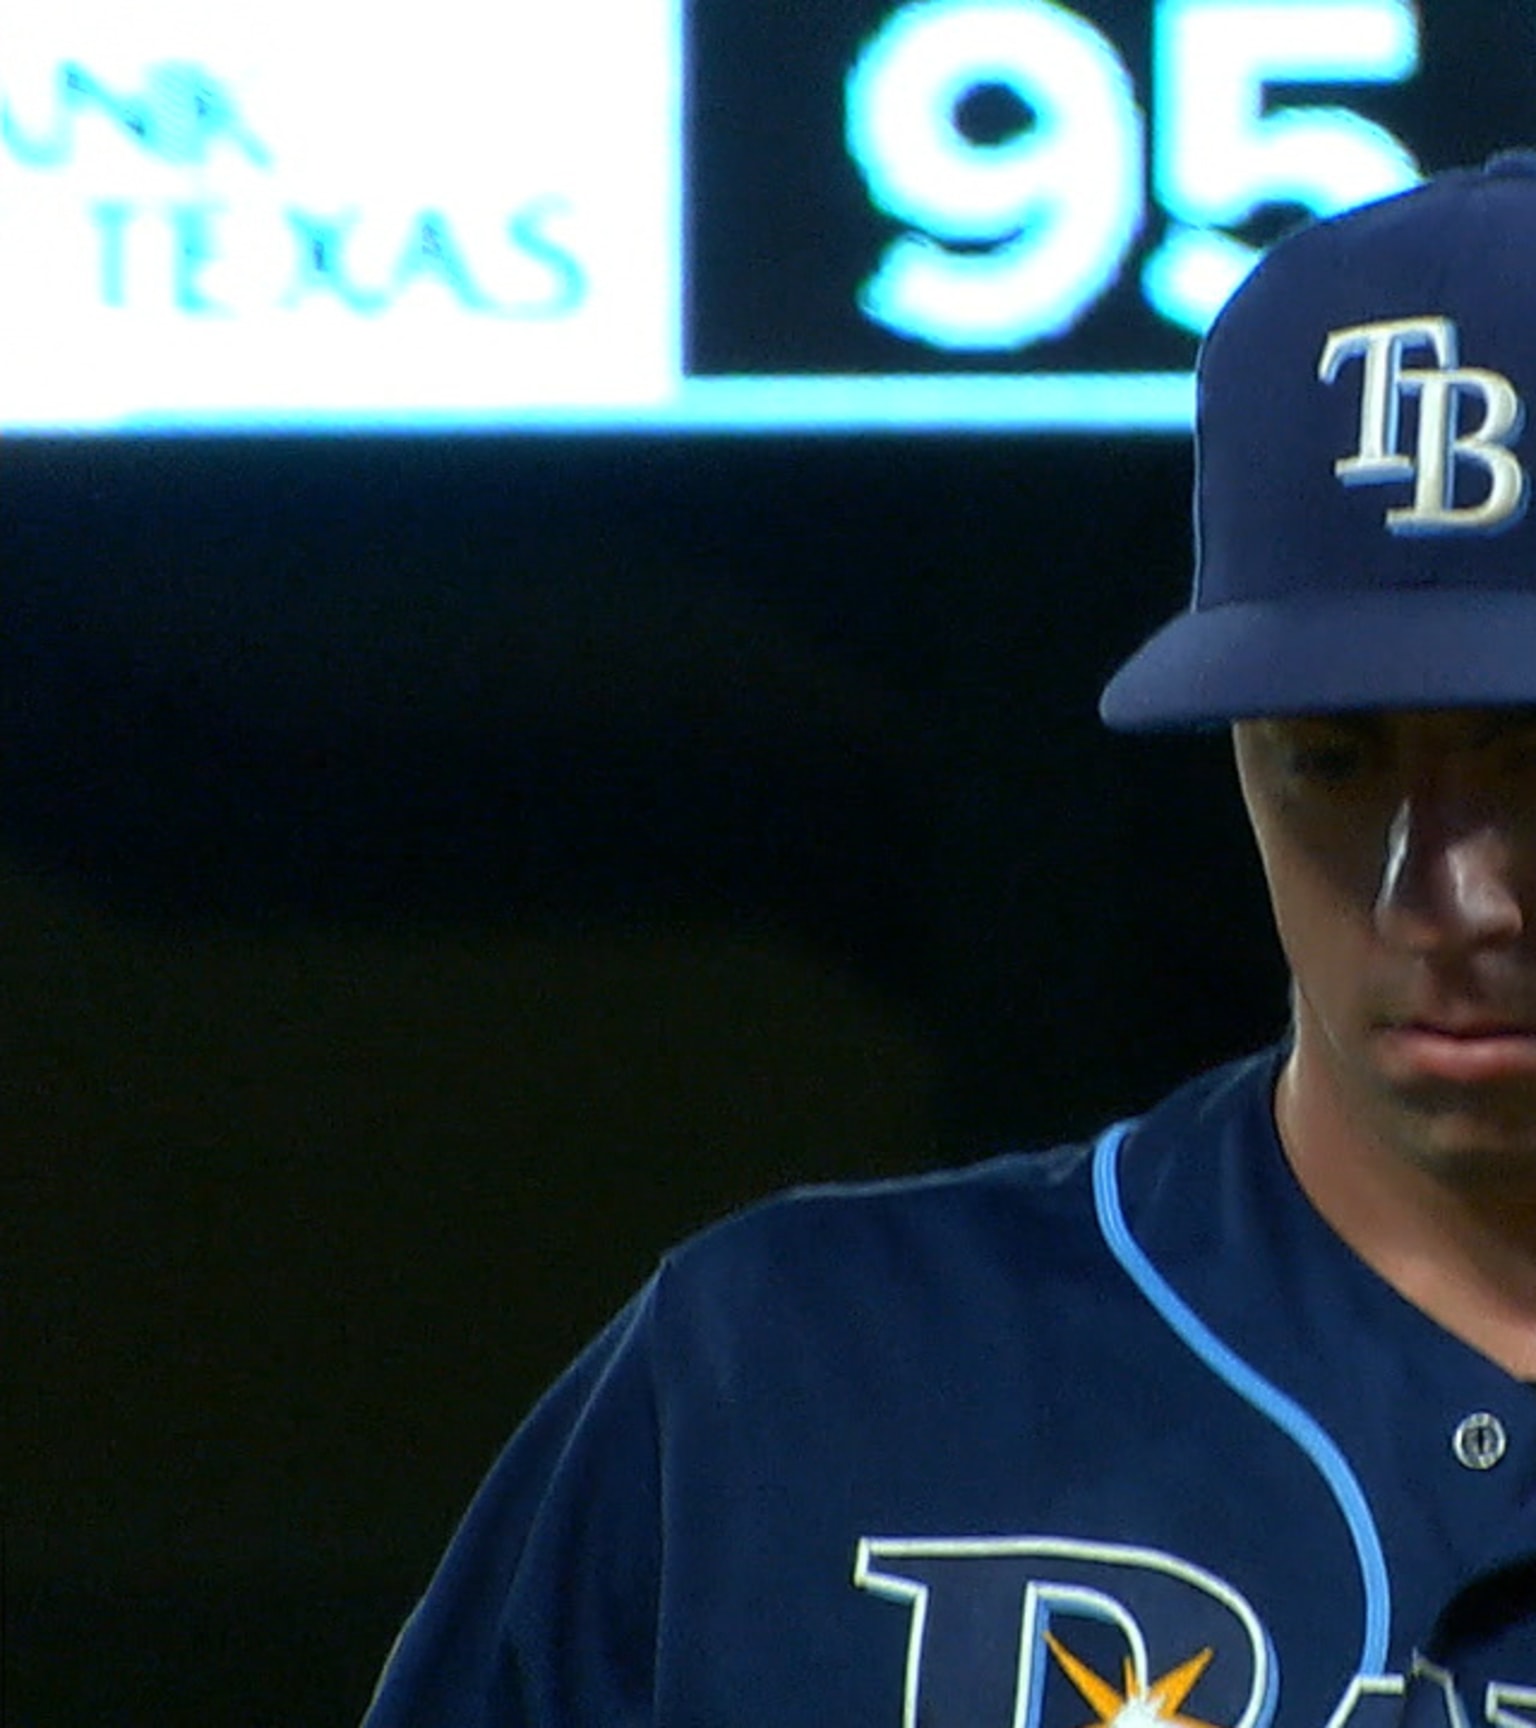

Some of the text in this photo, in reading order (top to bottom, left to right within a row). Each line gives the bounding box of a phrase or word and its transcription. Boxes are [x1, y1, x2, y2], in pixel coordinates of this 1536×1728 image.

[86, 195, 592, 320] TEXAS
[843, 0, 1422, 353] 95
[1317, 314, 1532, 537] TB
